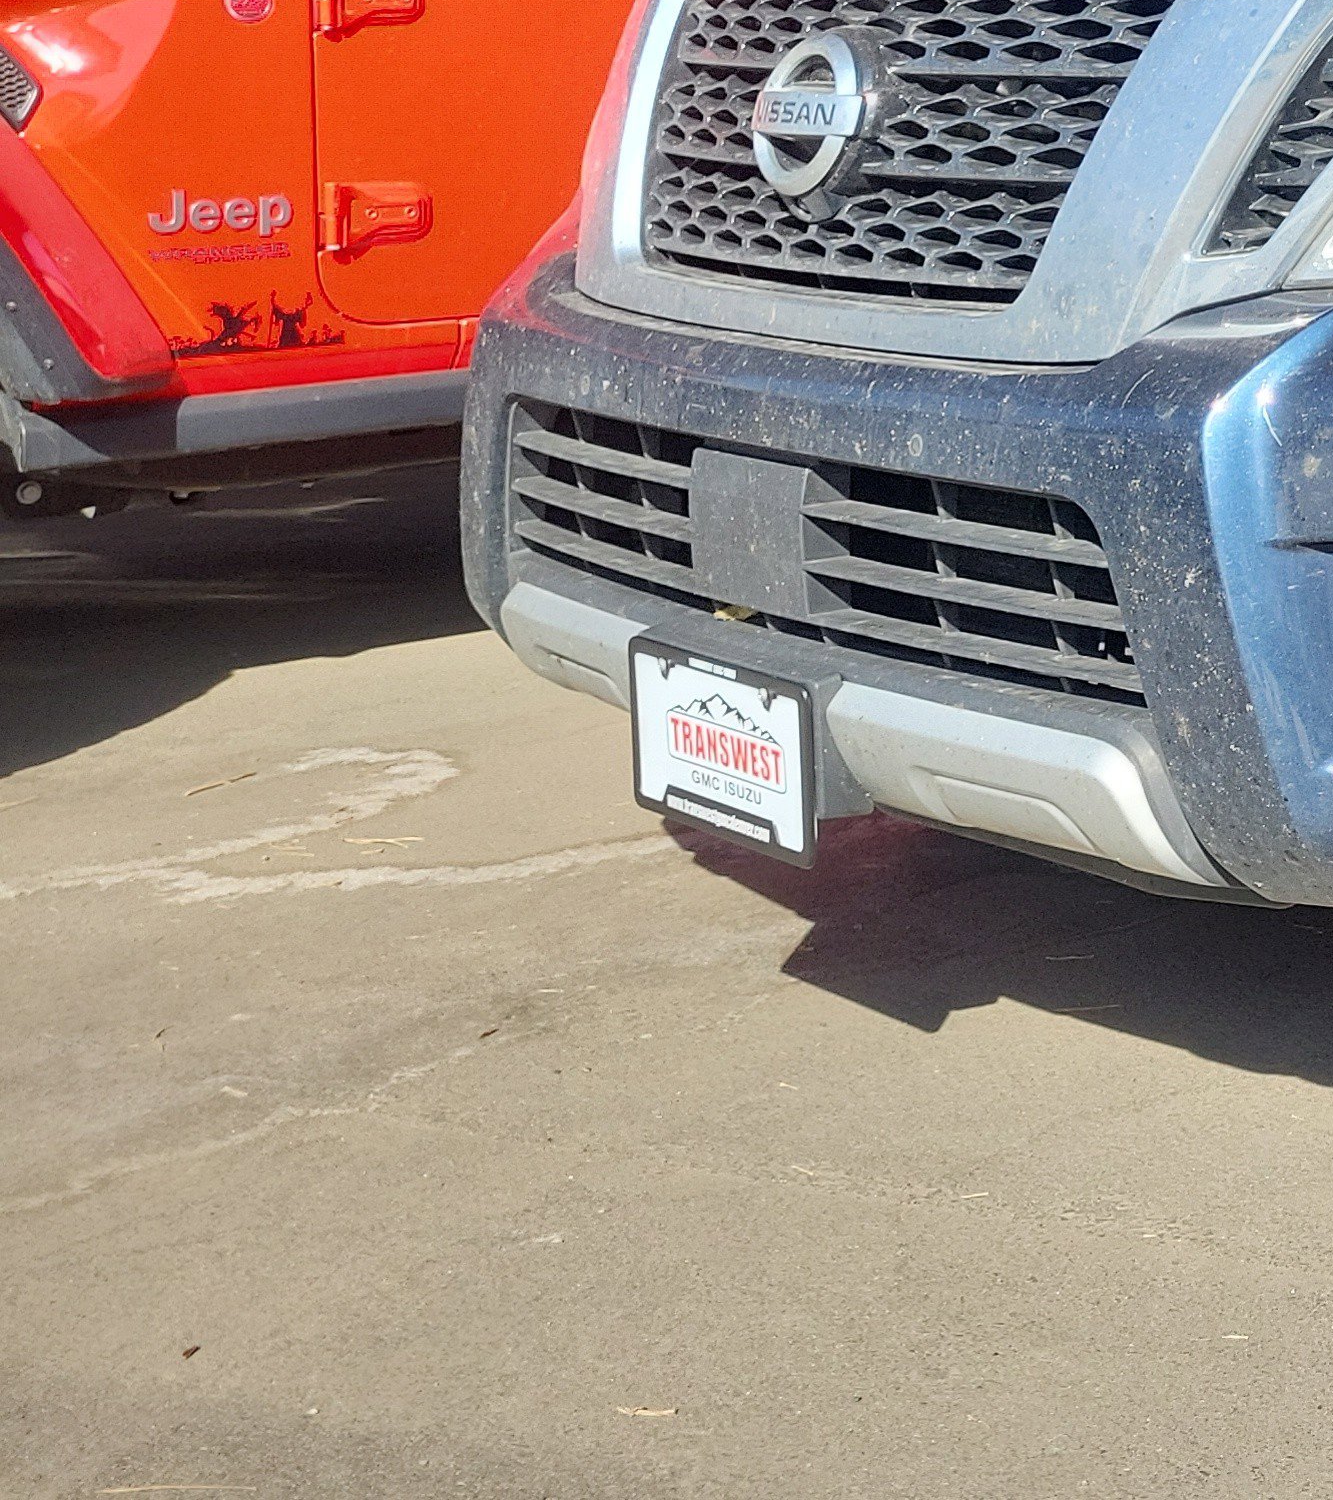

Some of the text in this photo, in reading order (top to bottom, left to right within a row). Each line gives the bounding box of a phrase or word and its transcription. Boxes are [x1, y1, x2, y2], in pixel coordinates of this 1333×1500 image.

[756, 99, 836, 126] NISSAN
[148, 189, 293, 236] Jeep
[671, 717, 781, 785] TRANSWEST
[691, 770, 763, 805] GMC ISUZU
